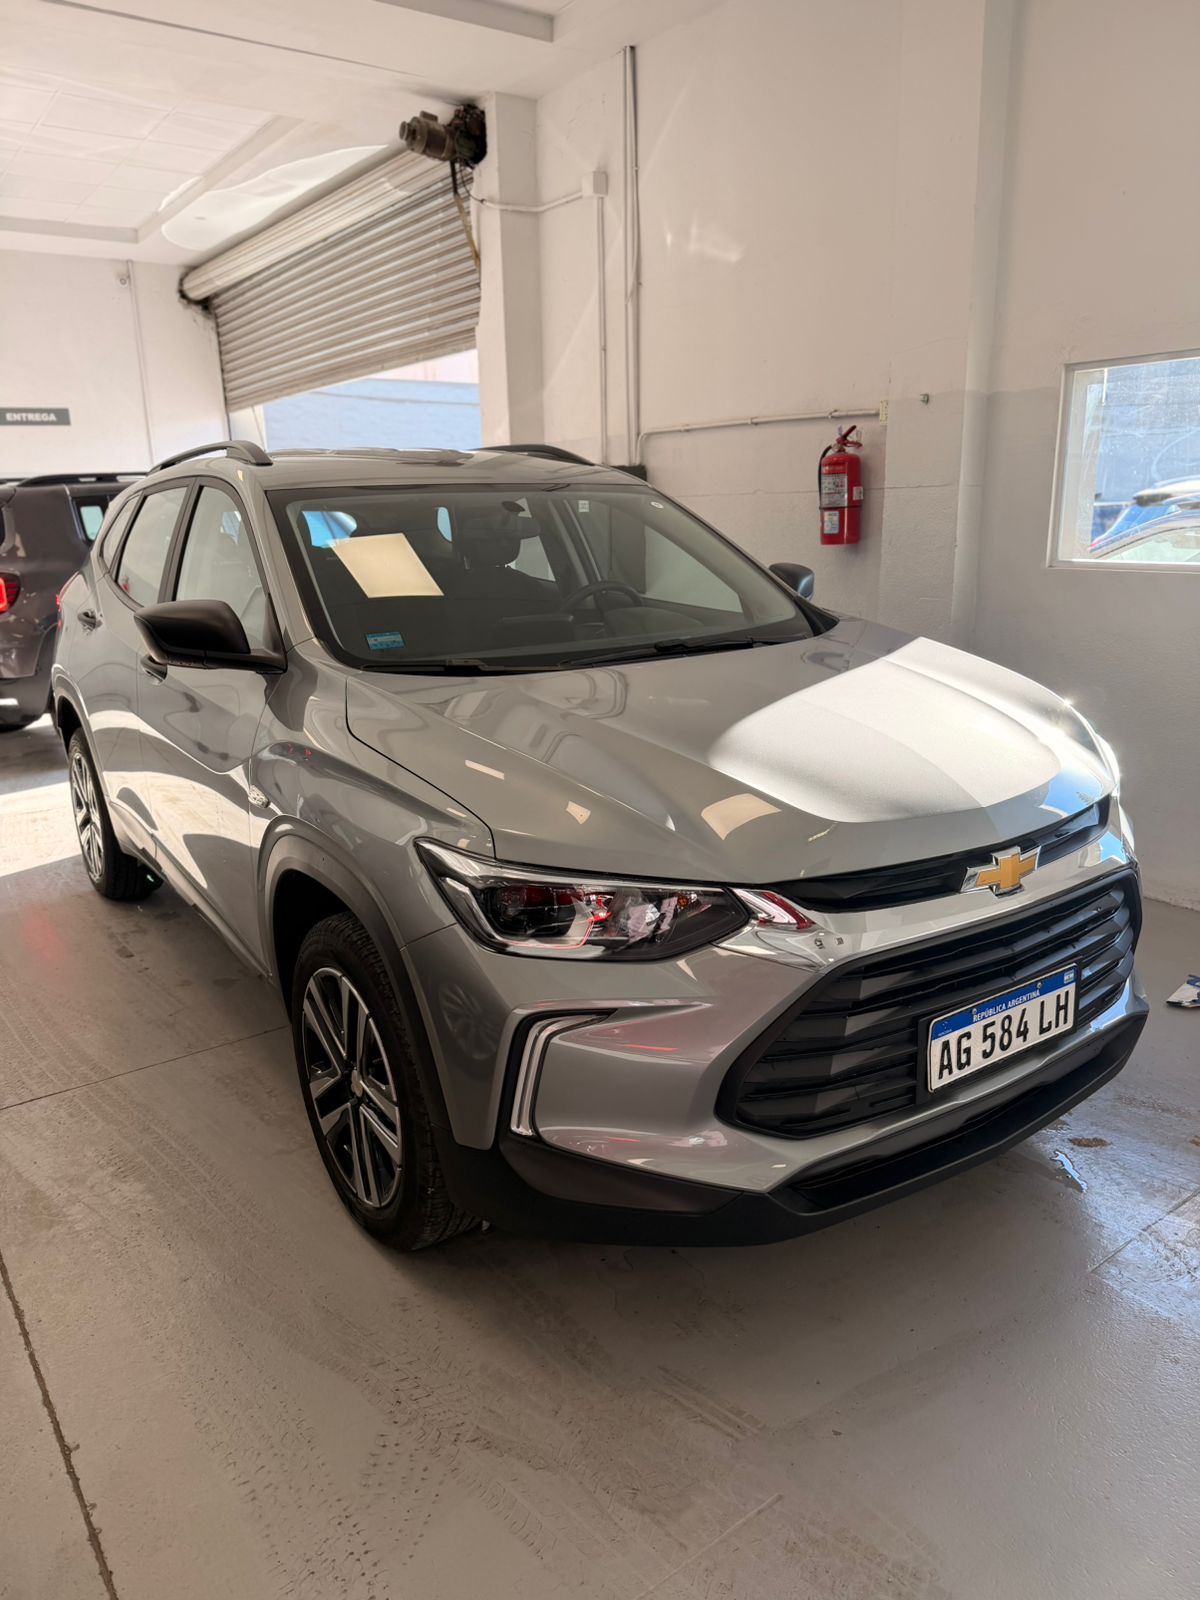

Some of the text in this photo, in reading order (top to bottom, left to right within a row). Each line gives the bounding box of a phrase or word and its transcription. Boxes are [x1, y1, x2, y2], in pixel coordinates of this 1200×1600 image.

[5, 412, 57, 421] ENTREGA
[973, 989, 1041, 1022] REPÚBLICA ARGENTINA
[938, 990, 1070, 1080] AG 584 LH
